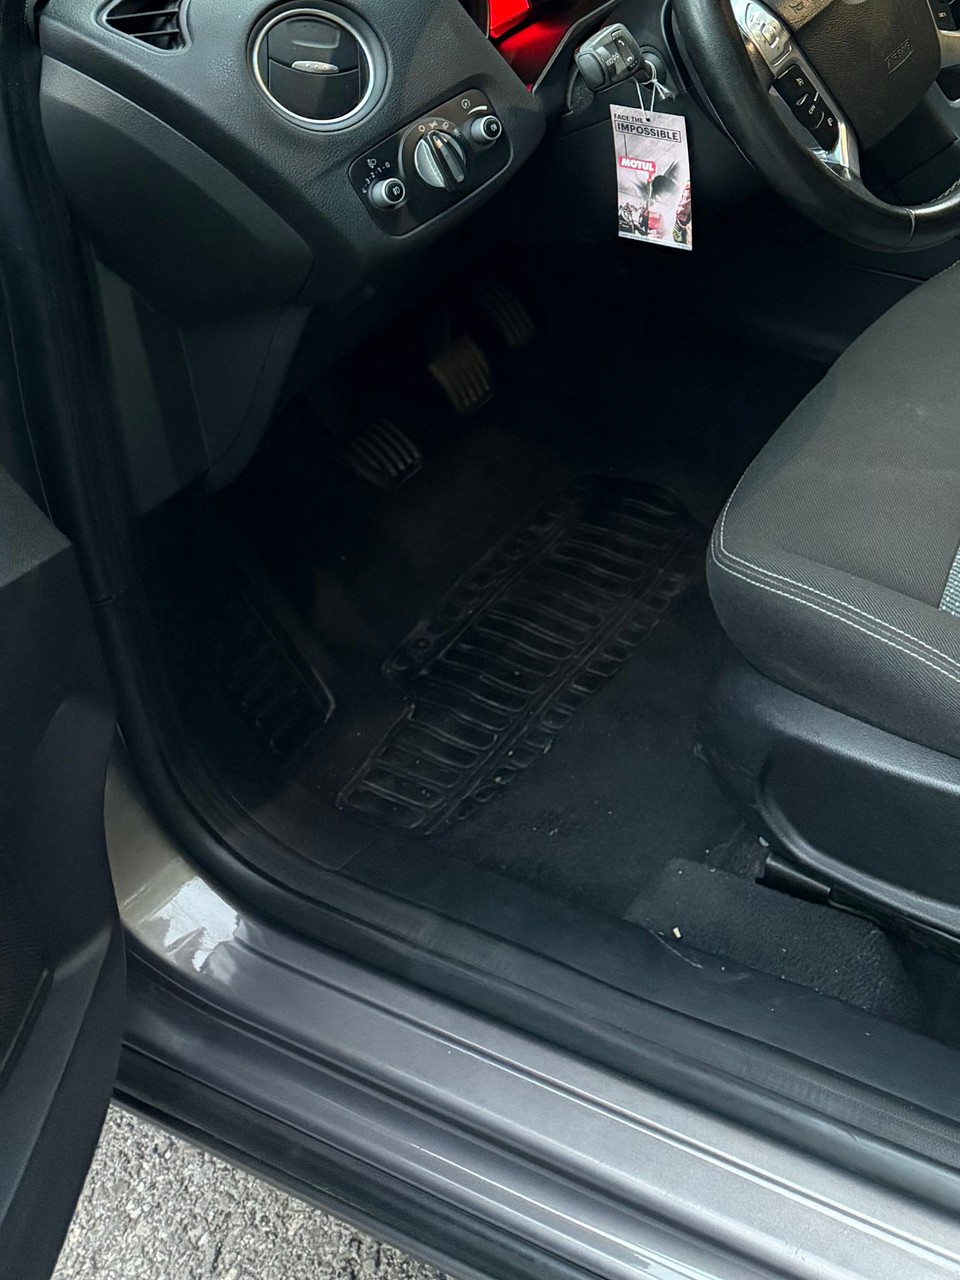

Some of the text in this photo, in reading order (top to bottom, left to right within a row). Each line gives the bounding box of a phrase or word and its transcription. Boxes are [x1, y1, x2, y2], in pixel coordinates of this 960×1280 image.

[614, 113, 644, 124] FACE THE
[617, 122, 679, 141] IMPOSSIBLE
[621, 157, 654, 171] MOTUL
